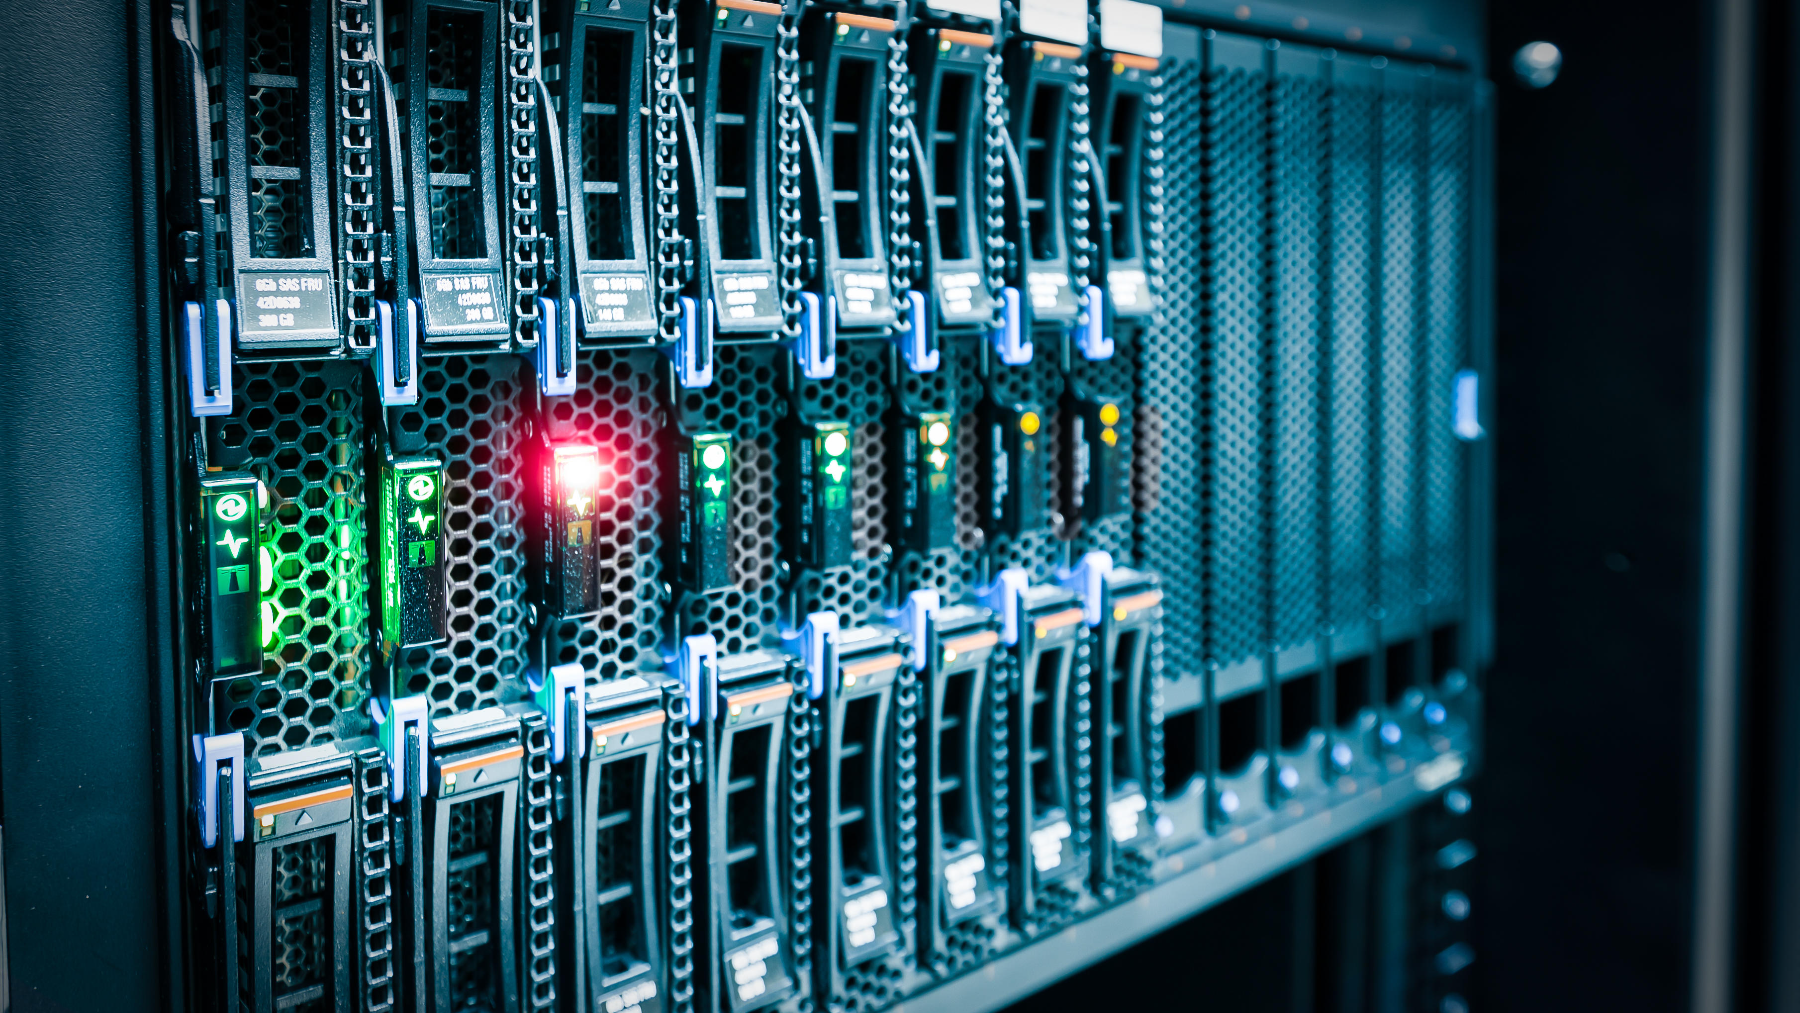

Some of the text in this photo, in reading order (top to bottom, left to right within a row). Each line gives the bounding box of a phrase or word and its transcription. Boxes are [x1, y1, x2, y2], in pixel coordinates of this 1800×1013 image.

[278, 278, 300, 291] SAS
[301, 278, 322, 291] FRU
[279, 313, 294, 327] GB
